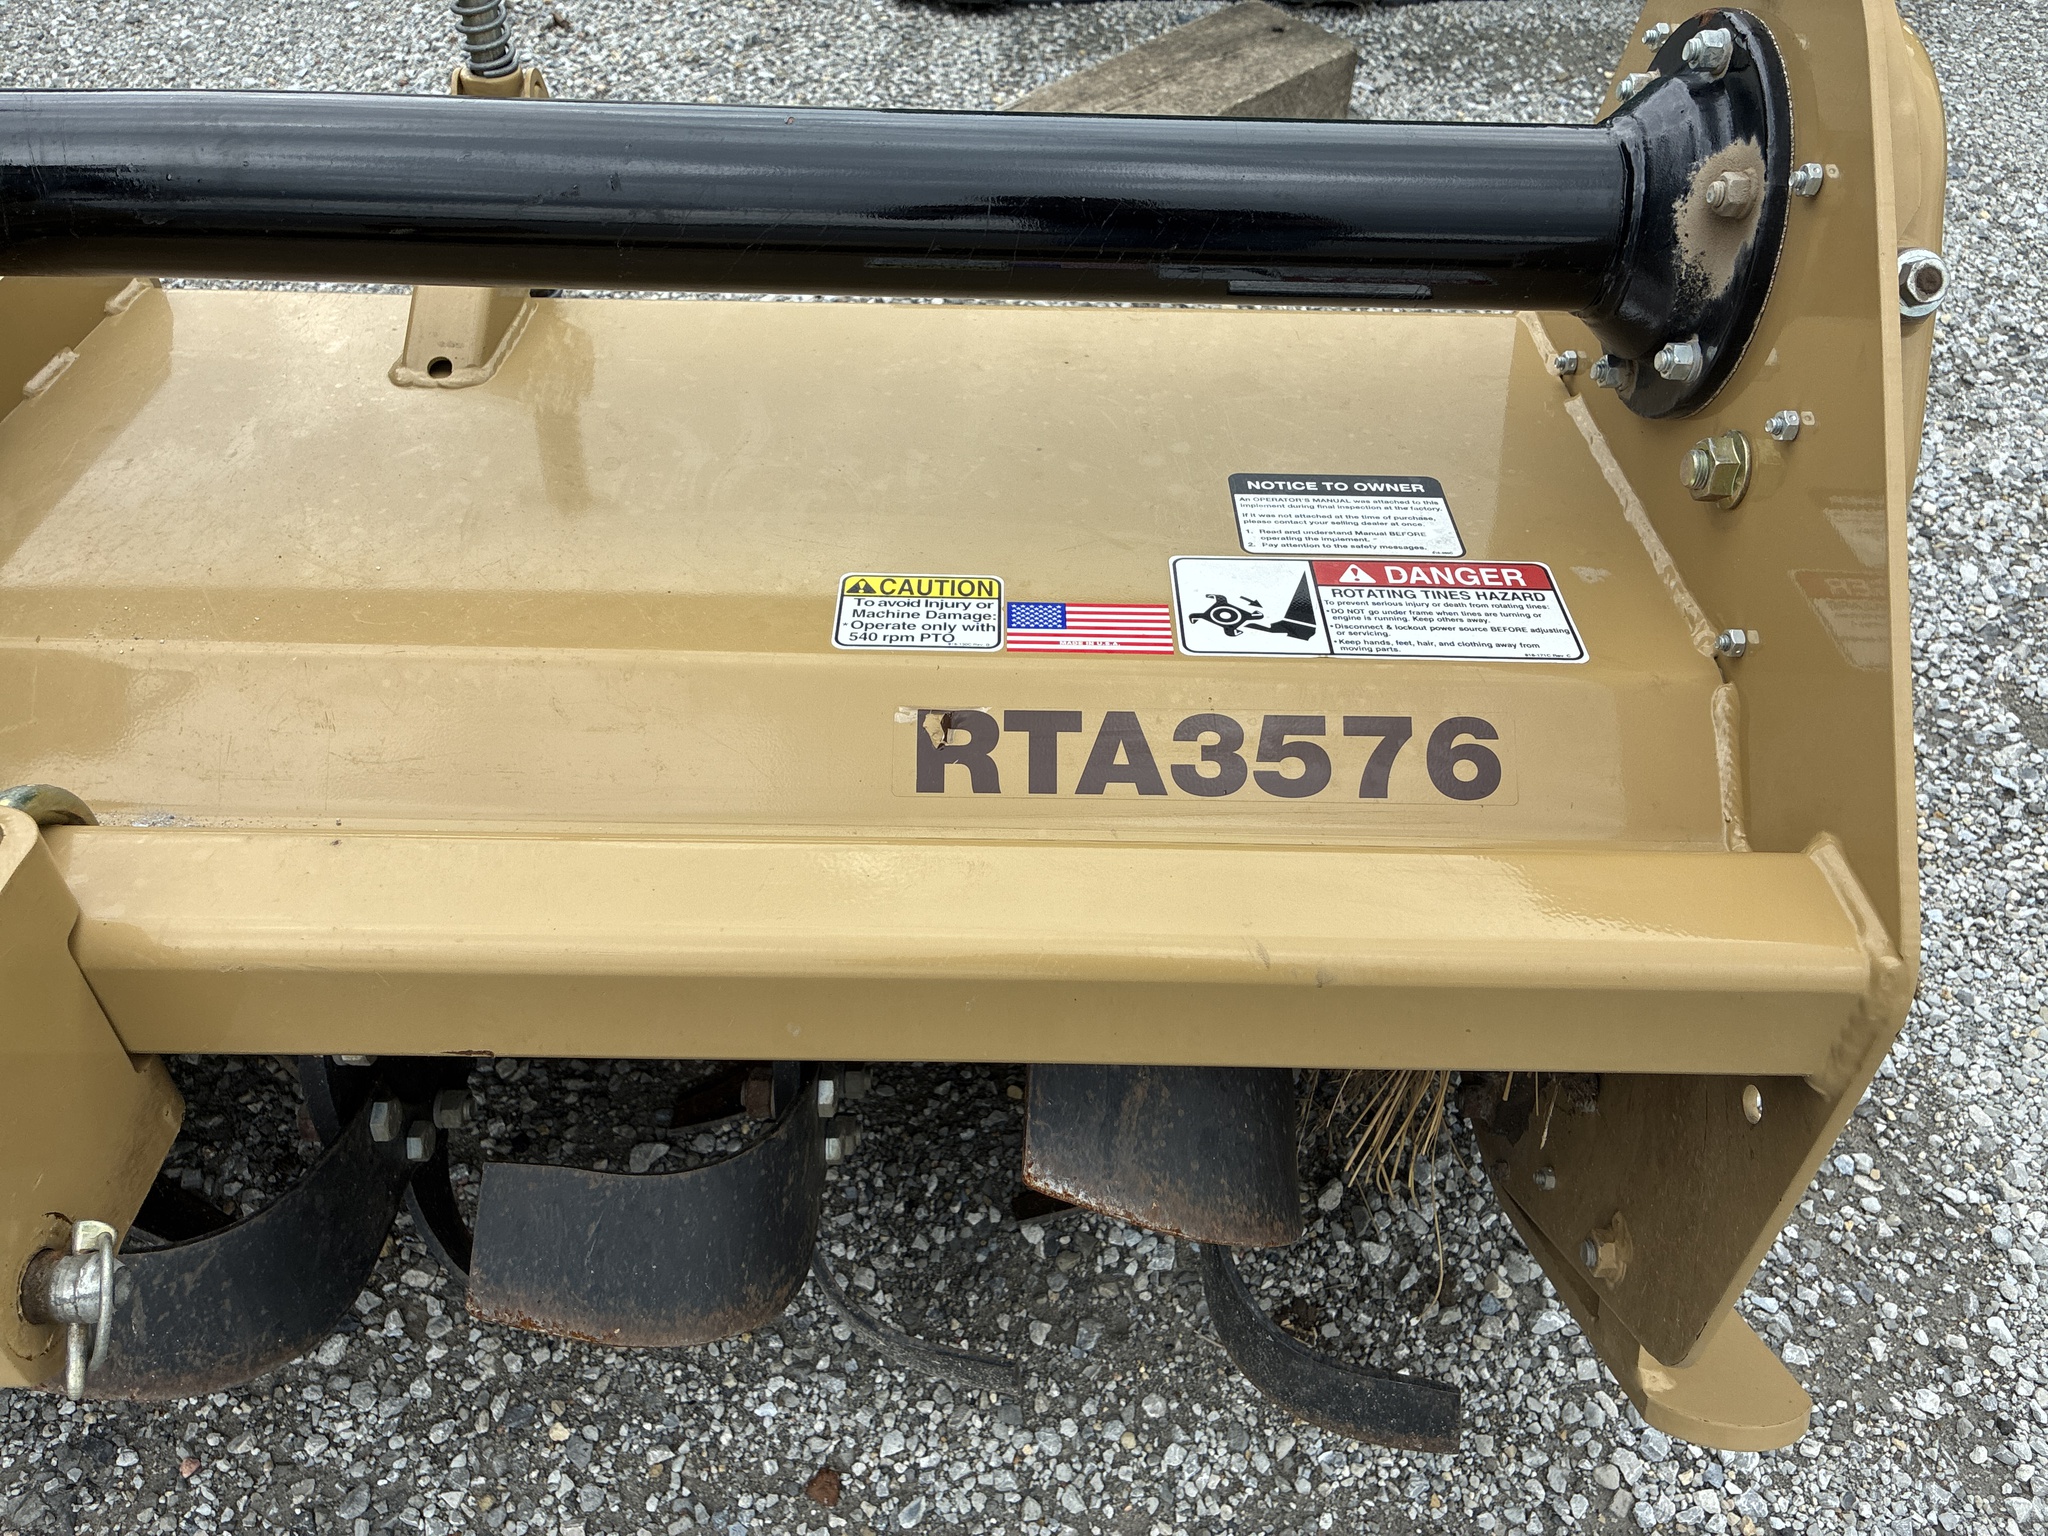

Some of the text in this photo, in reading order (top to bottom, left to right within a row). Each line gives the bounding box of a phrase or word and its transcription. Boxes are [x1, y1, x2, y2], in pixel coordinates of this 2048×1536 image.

[1246, 480, 1425, 492] NOTICE TO OWNER
[1384, 566, 1527, 586] DANGER
[880, 578, 993, 596] CAUTION
[1331, 588, 1545, 601] ROTATING TINES HAZARD
[854, 598, 875, 607] To
[878, 599, 920, 607] avoid
[924, 599, 971, 610] Injury
[852, 609, 996, 622] Machine Damage:
[851, 620, 996, 633] Operate only with
[849, 632, 955, 643] 540 rpm PTO
[915, 709, 1502, 801] RTA3576
